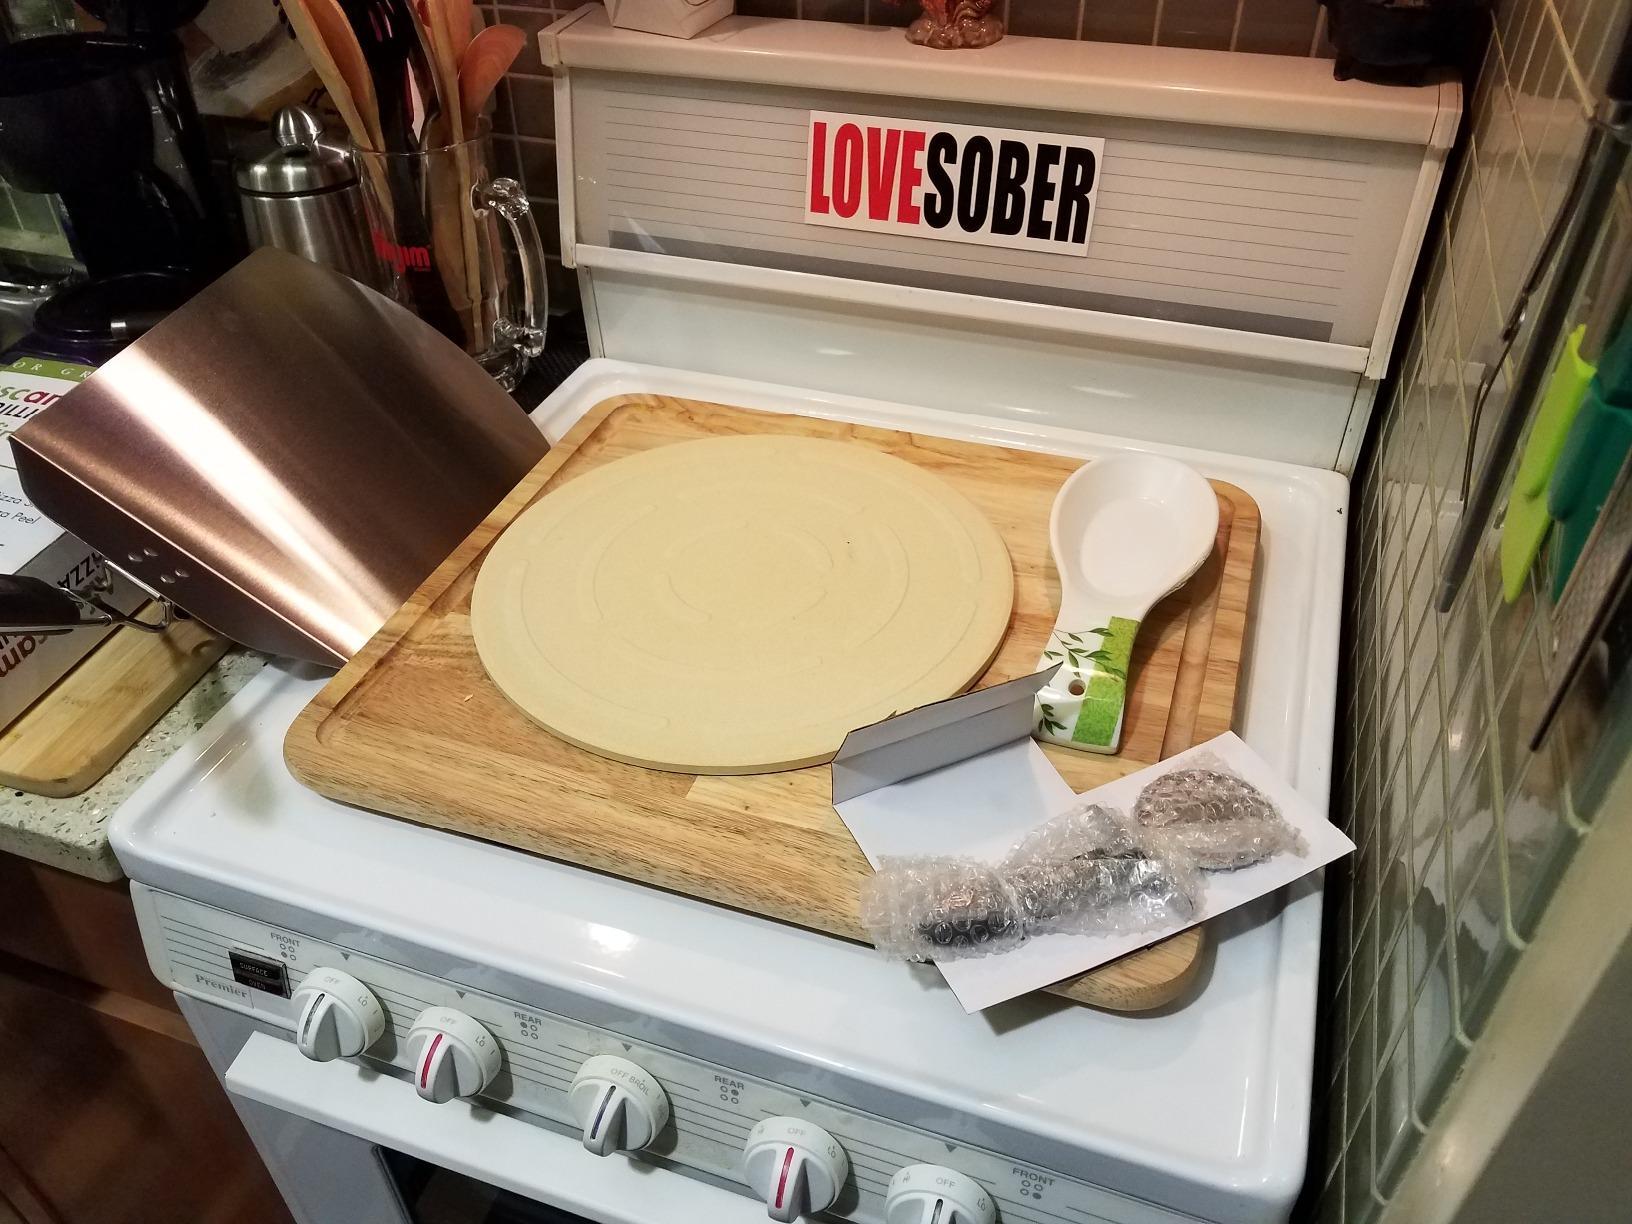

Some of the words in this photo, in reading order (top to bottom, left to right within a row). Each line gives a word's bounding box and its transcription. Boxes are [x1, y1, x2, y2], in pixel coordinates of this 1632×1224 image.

[11, 511, 41, 524] Peel
[270, 932, 300, 947] FRONT
[195, 974, 248, 998] Premier
[514, 1011, 542, 1026] REAR
[610, 1067, 629, 1080] OFF
[629, 1075, 650, 1096] BROIL
[714, 1074, 745, 1090] REAR
[935, 1176, 957, 1189] OFF
[1012, 1167, 1056, 1186] FRONT
